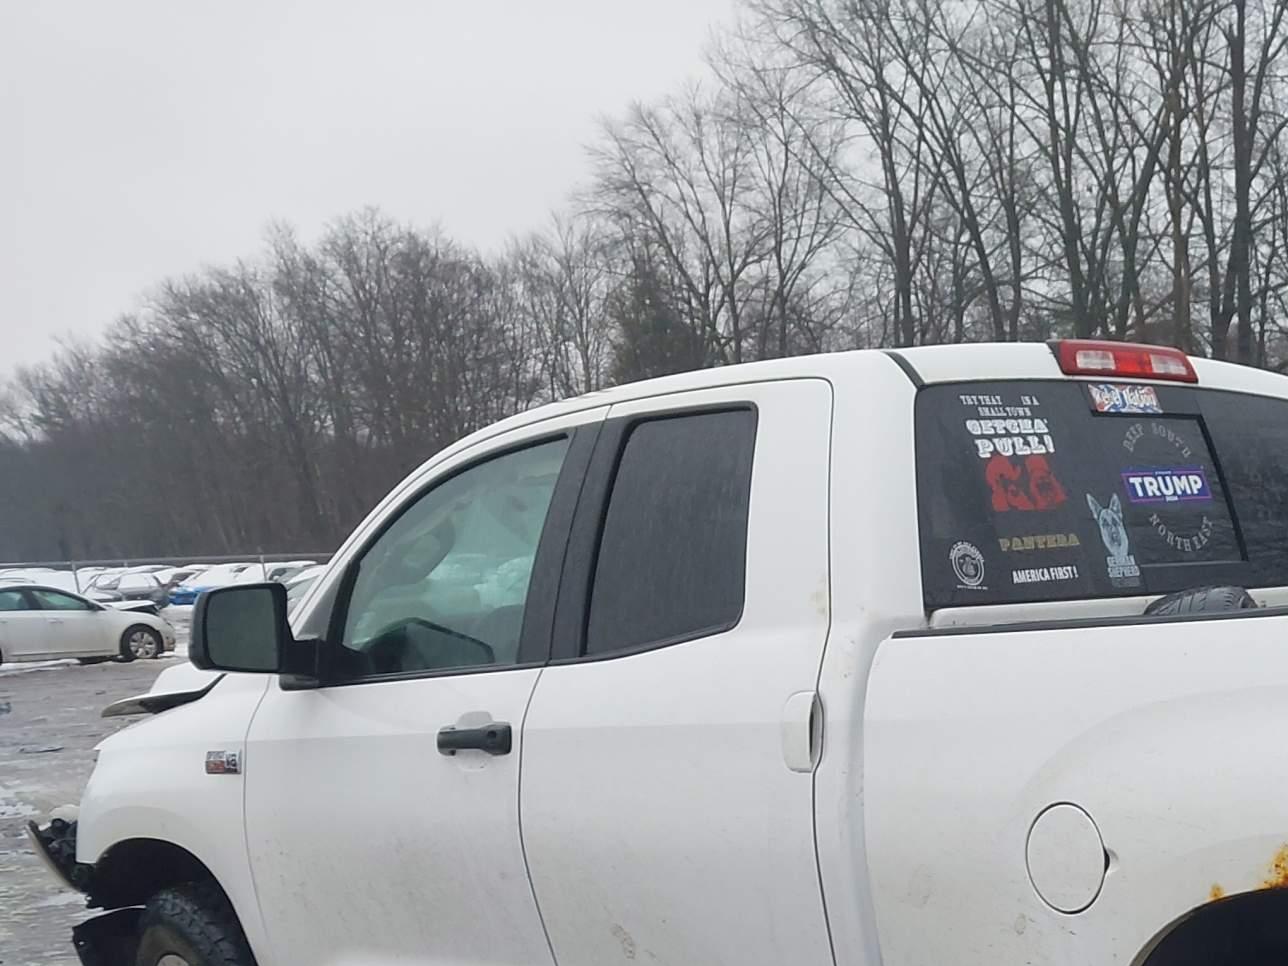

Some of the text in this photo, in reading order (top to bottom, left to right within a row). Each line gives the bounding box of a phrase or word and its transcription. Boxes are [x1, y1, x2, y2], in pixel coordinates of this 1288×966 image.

[1128, 474, 1203, 498] TRUMP
[998, 533, 1081, 552] PANTERA
[1012, 567, 1051, 584] AMERICA
